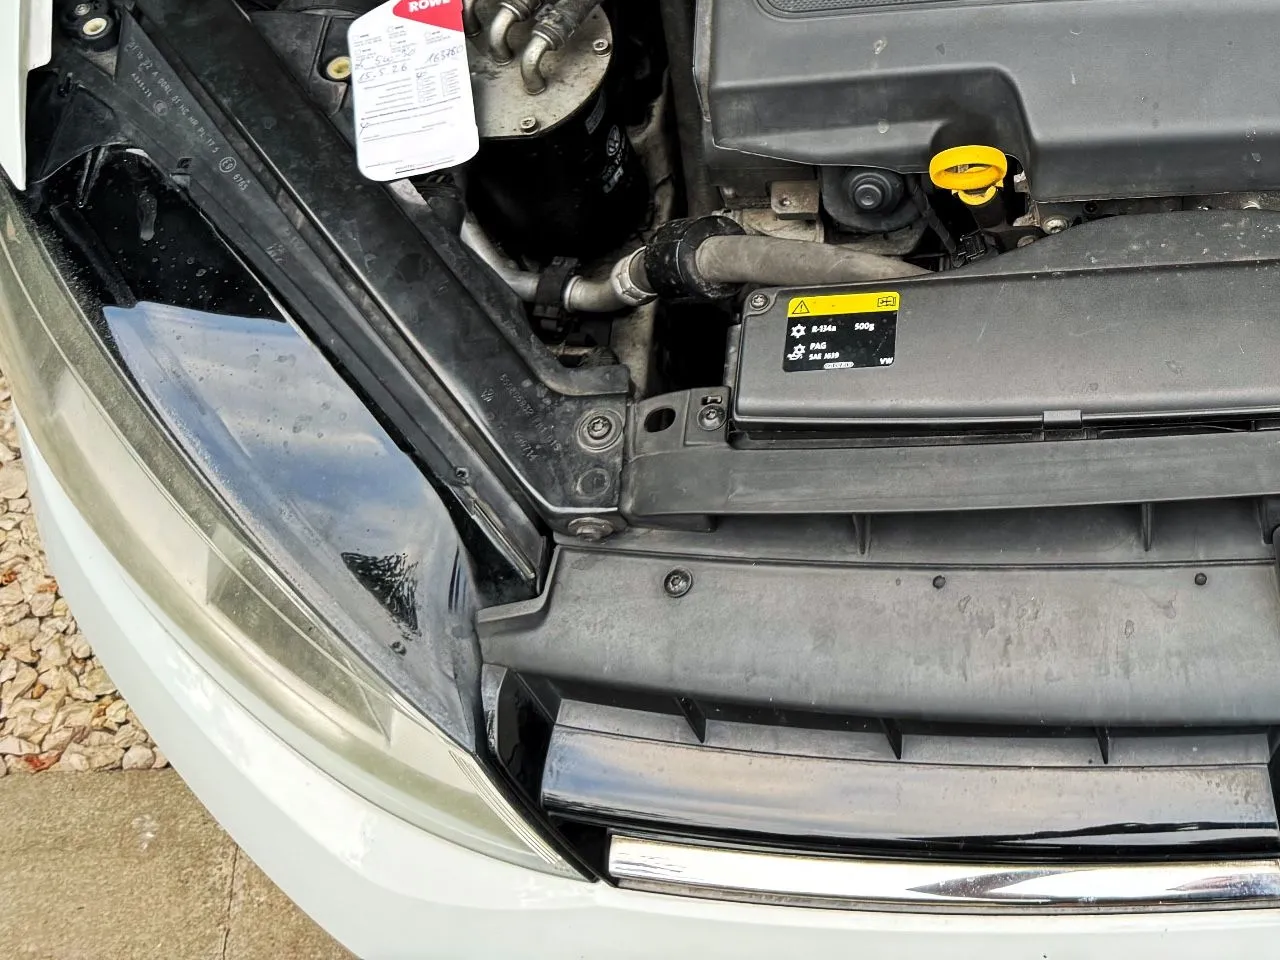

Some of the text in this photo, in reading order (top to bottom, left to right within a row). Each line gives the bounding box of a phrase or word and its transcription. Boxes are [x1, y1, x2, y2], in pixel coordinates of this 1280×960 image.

[811, 322, 875, 334] R-134a 500g
[810, 342, 827, 351] PAG
[809, 353, 823, 361] SAE
[880, 357, 894, 365] VW
